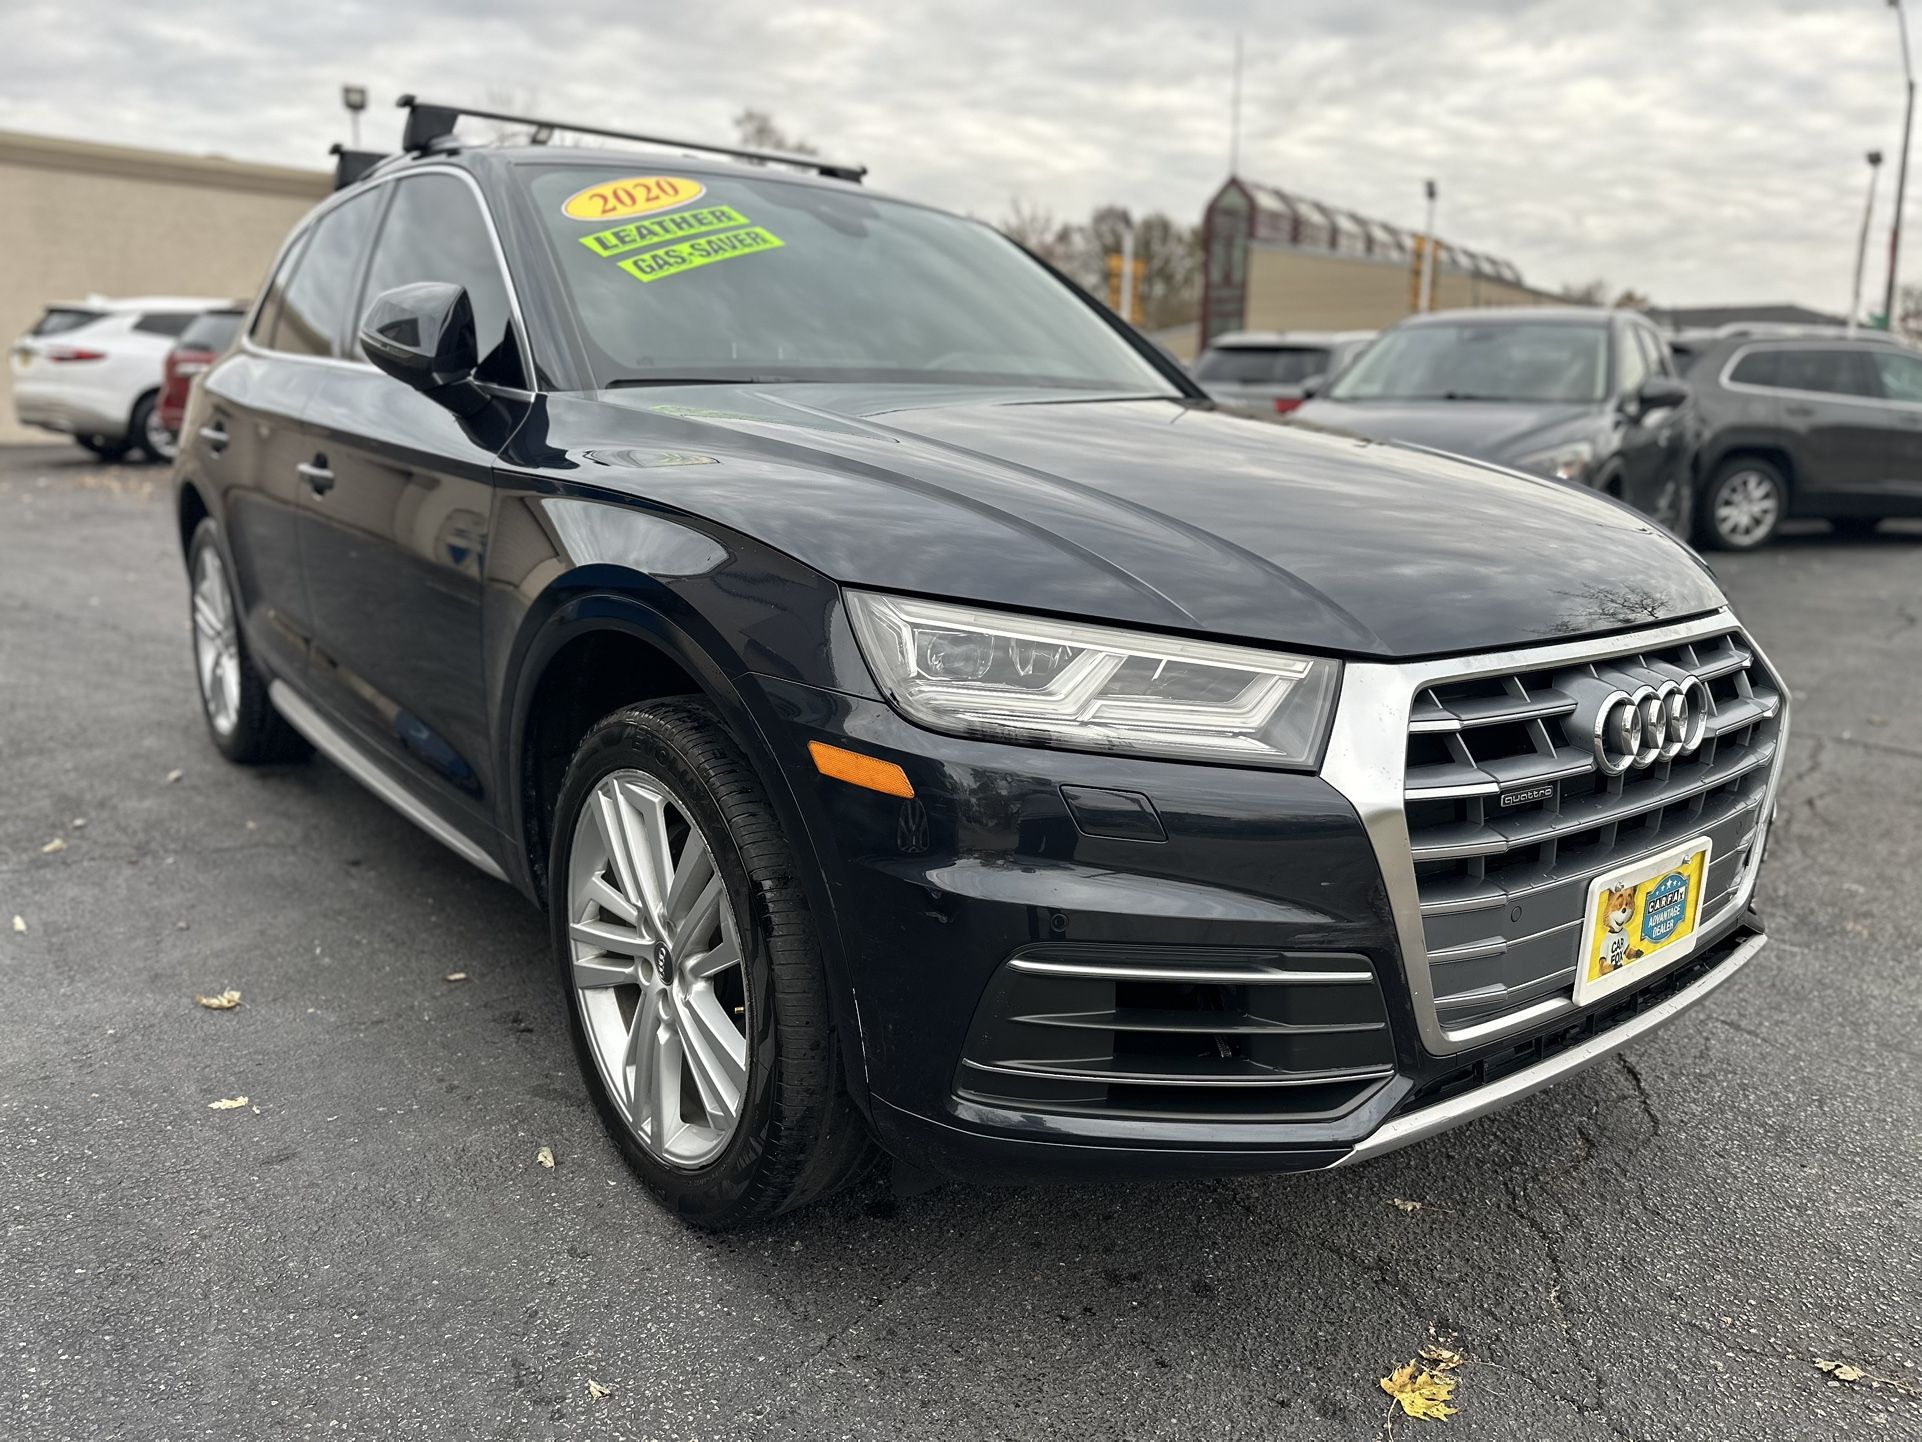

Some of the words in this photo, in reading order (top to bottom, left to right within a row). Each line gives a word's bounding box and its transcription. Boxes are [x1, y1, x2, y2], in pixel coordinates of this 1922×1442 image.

[588, 178, 680, 215] 2020
[594, 207, 735, 250] LEATHER
[632, 230, 769, 275] GAS-SAVER
[1504, 788, 1552, 804] quattro
[1648, 887, 1685, 914] CARFAX
[1648, 904, 1681, 928] ADVANTAGE
[1653, 919, 1674, 938] DEALER
[1611, 950, 1624, 966] FOX
